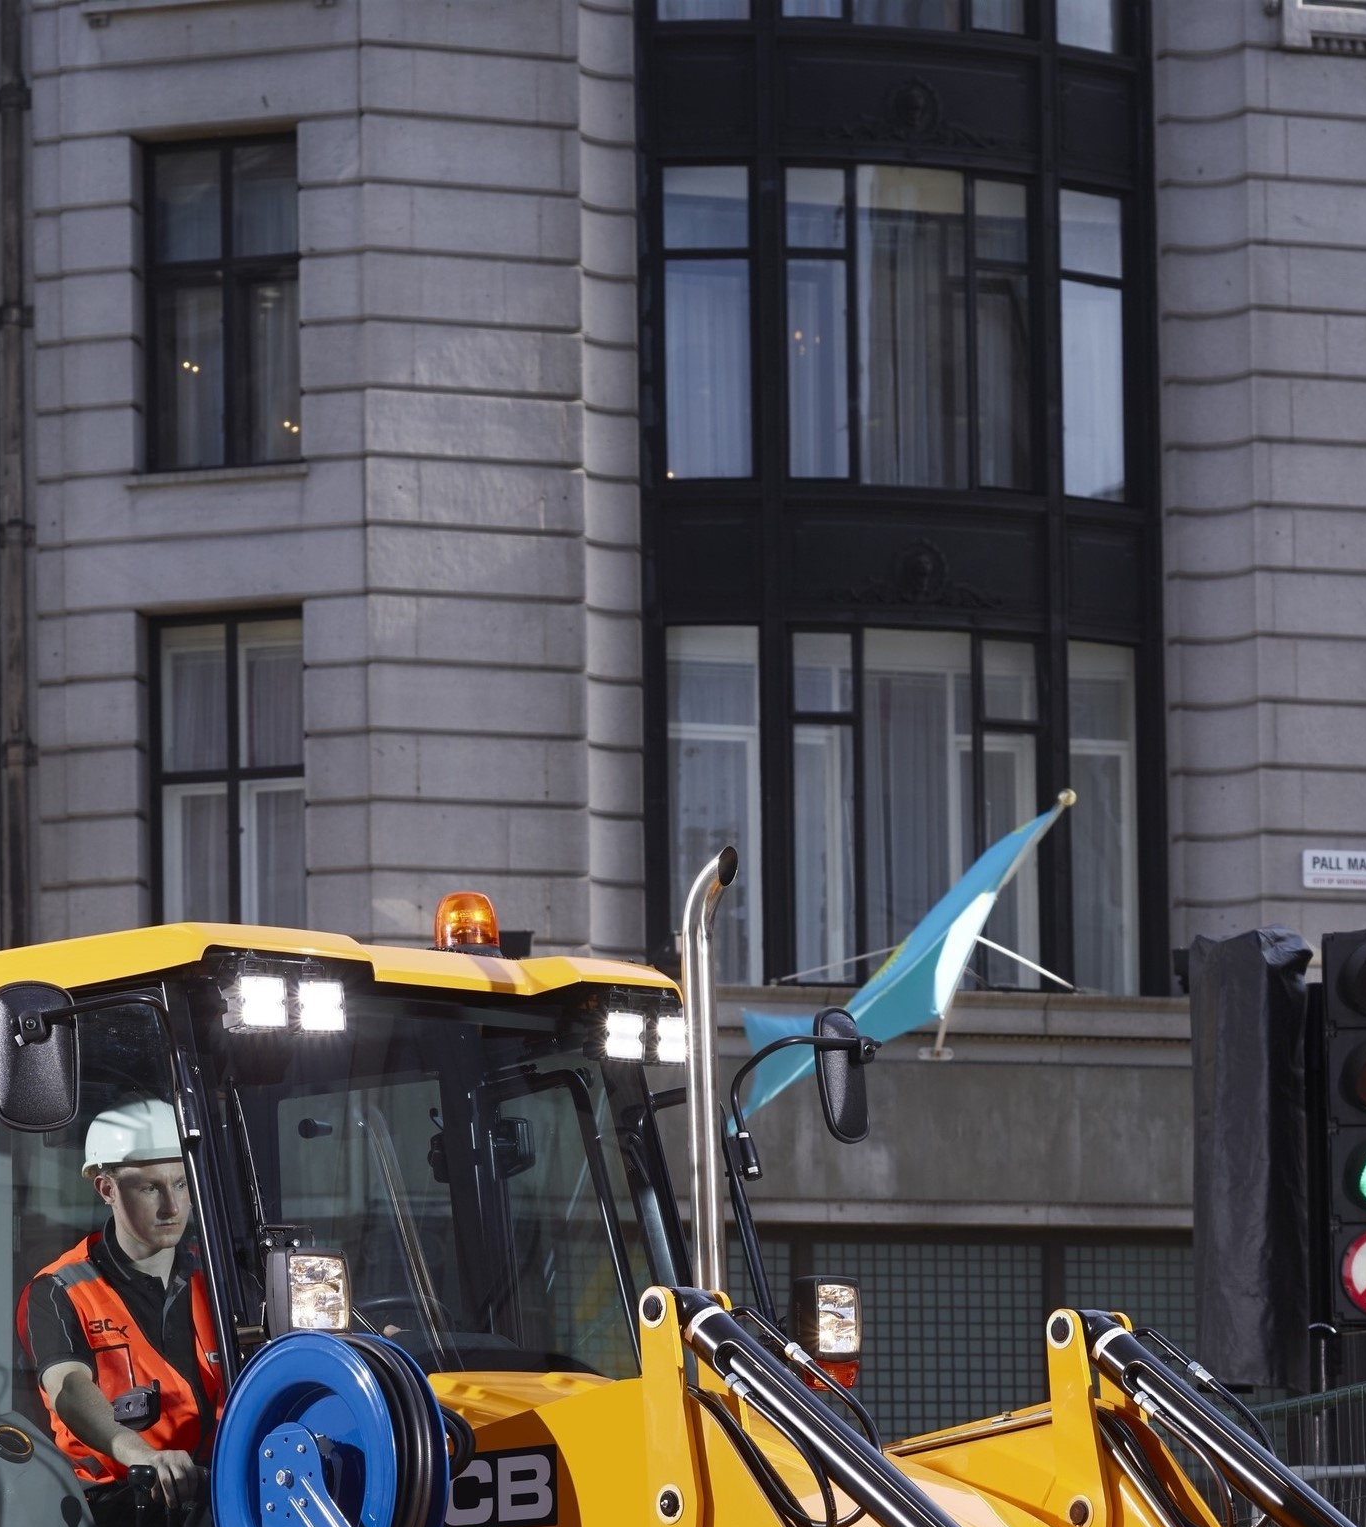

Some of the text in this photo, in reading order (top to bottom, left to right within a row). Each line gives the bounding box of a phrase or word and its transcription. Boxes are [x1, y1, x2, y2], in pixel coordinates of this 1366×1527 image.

[1312, 857, 1343, 870] PALL
[89, 1318, 130, 1339] 3CX
[445, 1453, 554, 1527] CB
